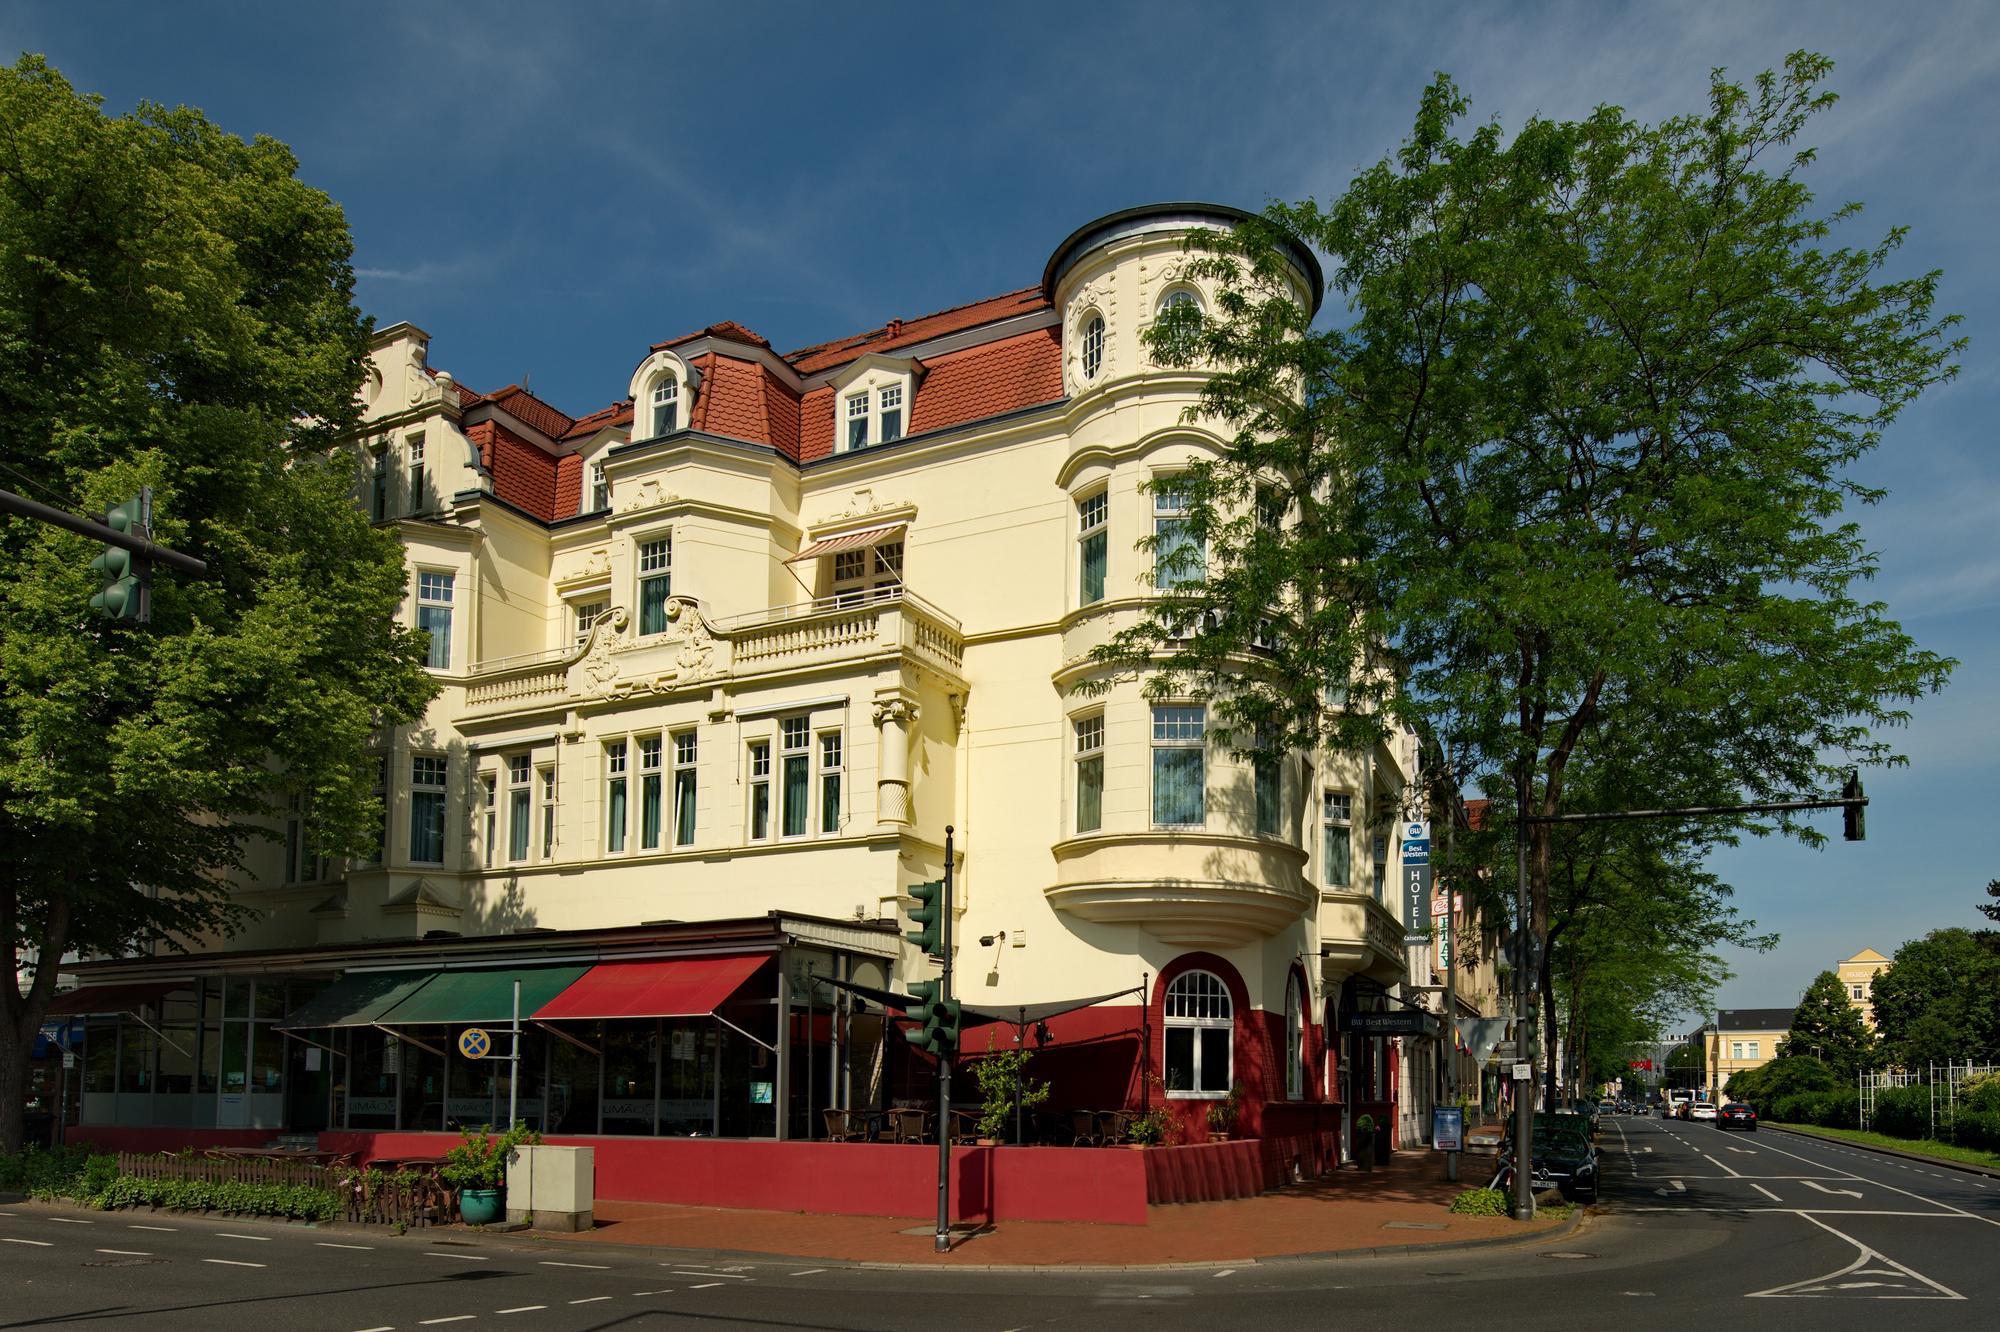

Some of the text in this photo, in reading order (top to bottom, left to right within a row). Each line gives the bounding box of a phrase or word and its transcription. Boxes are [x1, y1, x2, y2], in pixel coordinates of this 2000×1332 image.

[1409, 827, 1422, 835] BW
[1410, 870, 1420, 929] HOTEL
[1382, 1017, 1412, 1026] Western
